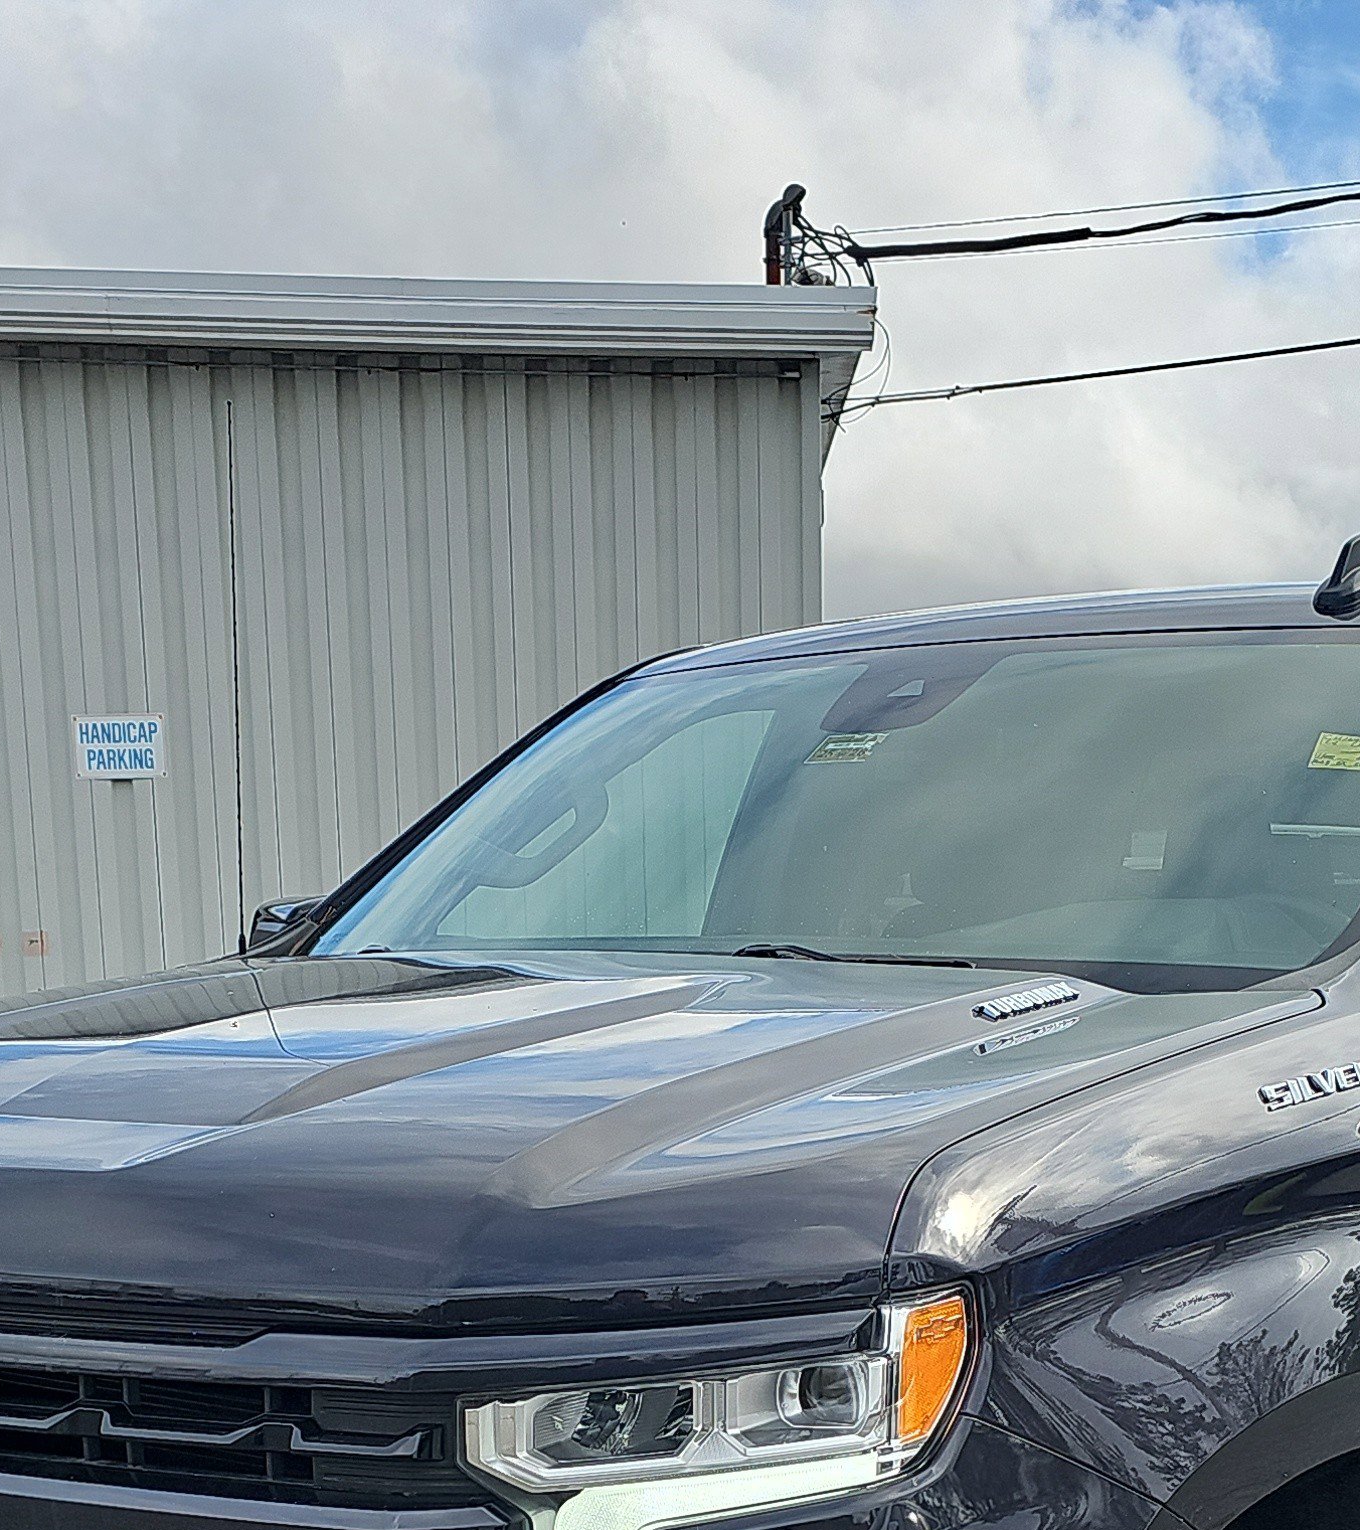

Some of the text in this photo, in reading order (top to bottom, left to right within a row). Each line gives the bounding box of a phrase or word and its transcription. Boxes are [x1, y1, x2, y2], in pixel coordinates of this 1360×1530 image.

[80, 721, 157, 744] HANDICAP
[87, 748, 154, 770] PARKING
[972, 981, 1080, 1022] TURBOMAX
